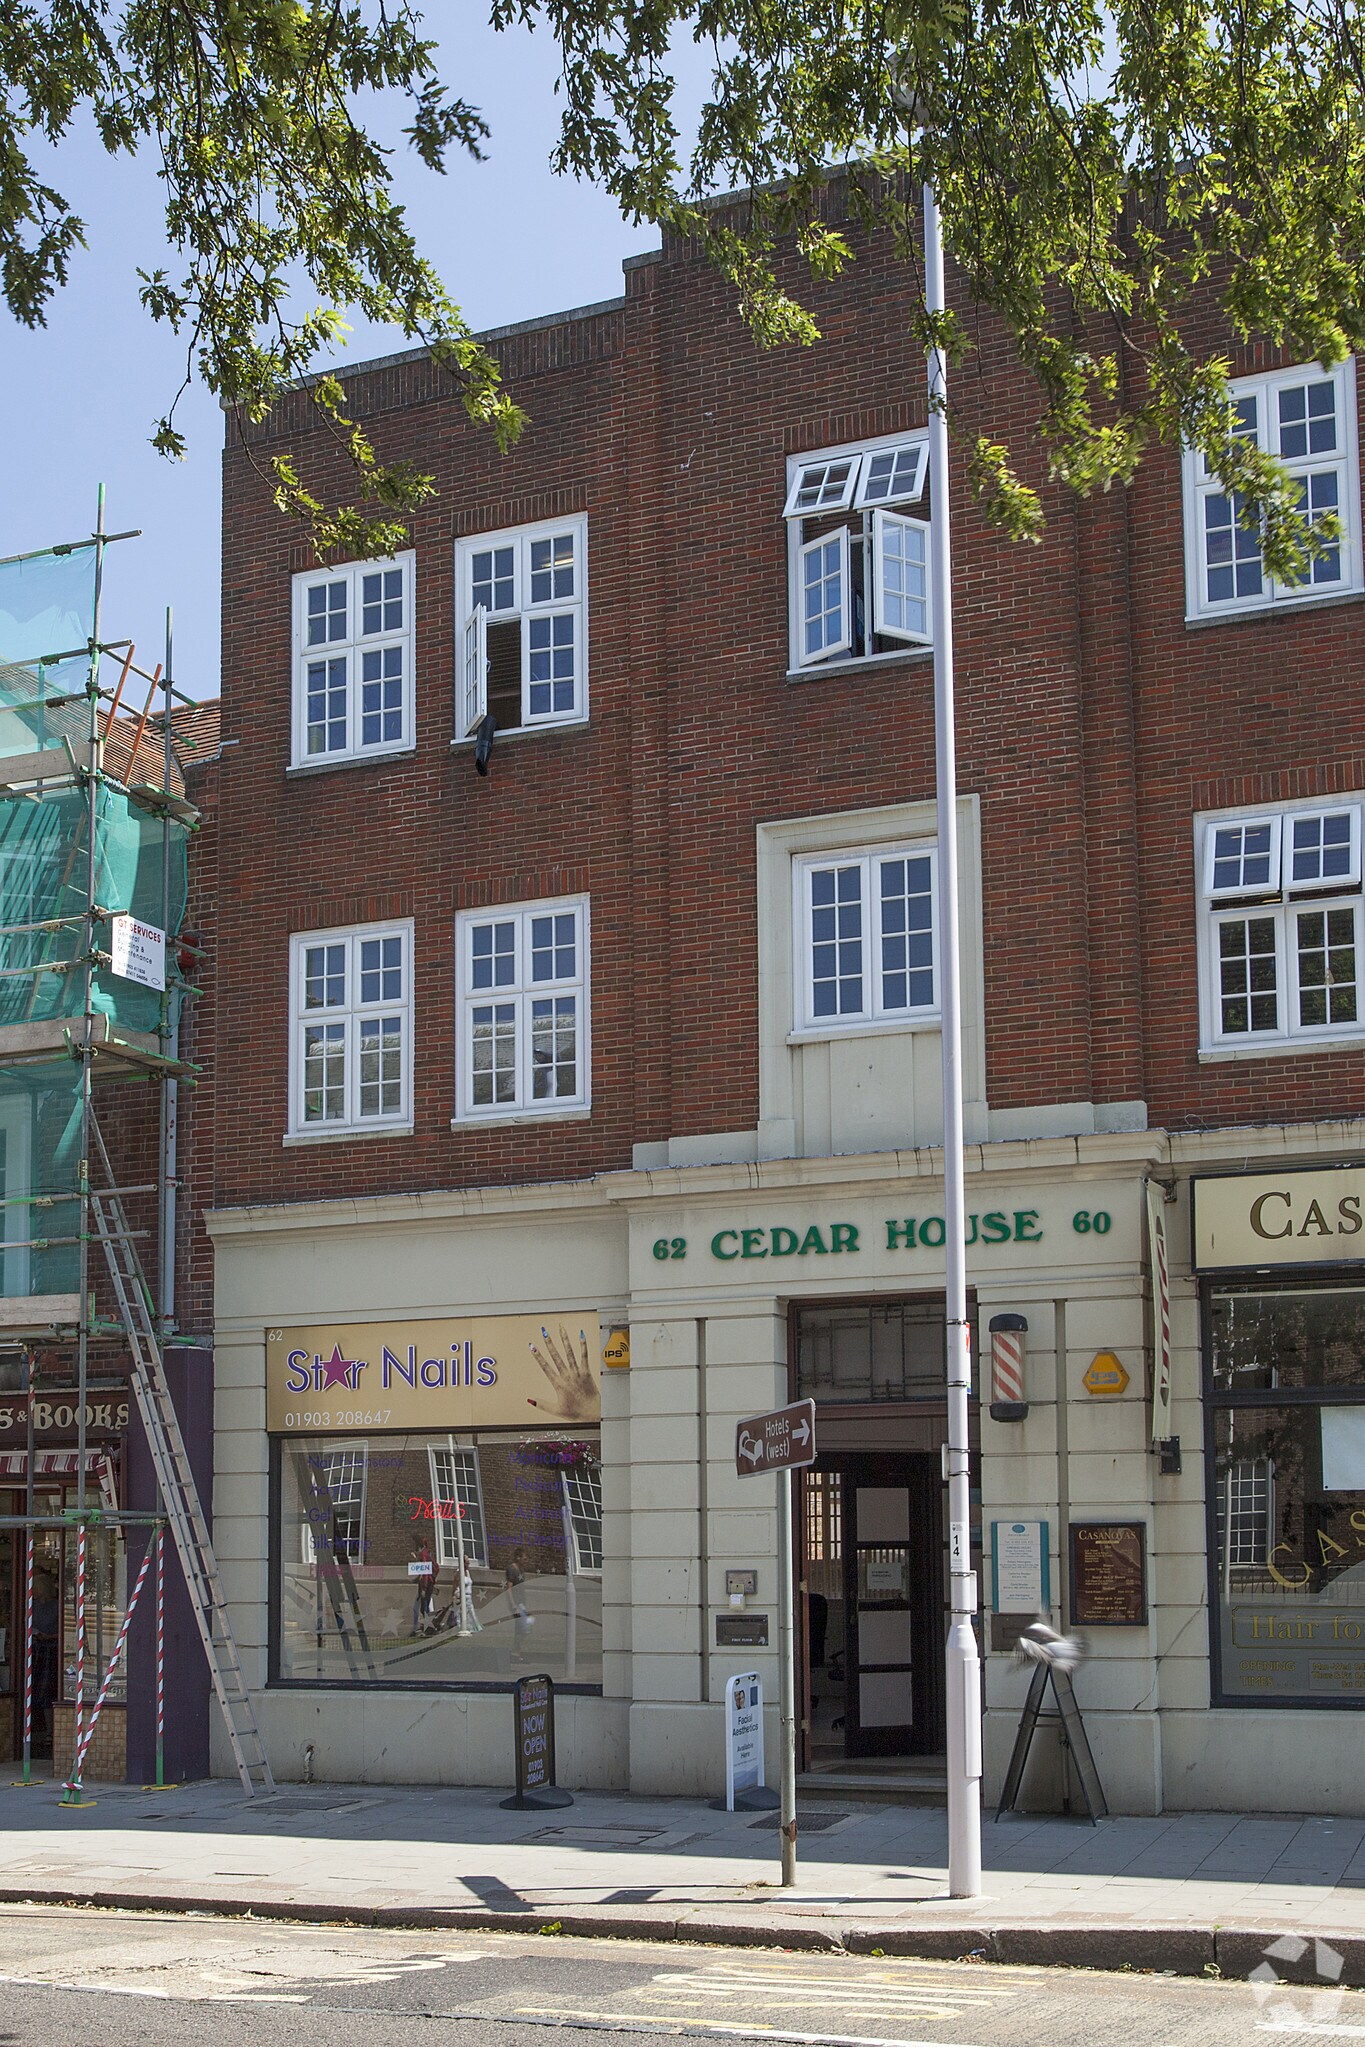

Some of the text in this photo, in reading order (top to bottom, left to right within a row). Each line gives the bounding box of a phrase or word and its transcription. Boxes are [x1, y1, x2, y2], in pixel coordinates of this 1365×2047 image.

[117, 918, 162, 944] GT SERVICES
[652, 1237, 687, 1260] 62
[710, 1223, 860, 1260] CEDAR
[1072, 1210, 1111, 1235] 60
[268, 1330, 283, 1341] 62
[381, 1340, 497, 1389] Nails
[604, 1350, 623, 1358] IPS
[16, 1410, 28, 1423] &
[33, 1402, 128, 1431] BOOKS
[285, 1410, 391, 1427] 01903 208647
[765, 1417, 790, 1438] Hotels
[766, 1437, 790, 1462] (west)
[308, 1506, 331, 1522] Gel
[408, 1497, 466, 1520] Nails
[1078, 1529, 1136, 1541] CASANOVAS
[410, 1564, 430, 1572] OPEN
[1250, 1614, 1365, 1640] Hair fo
[1240, 1661, 1296, 1671] OPENING
[523, 1713, 545, 1735] NOW
[732, 1723, 759, 1736] Aesthetics
[737, 1713, 753, 1725] Facial
[523, 1733, 547, 1756] OPEN
